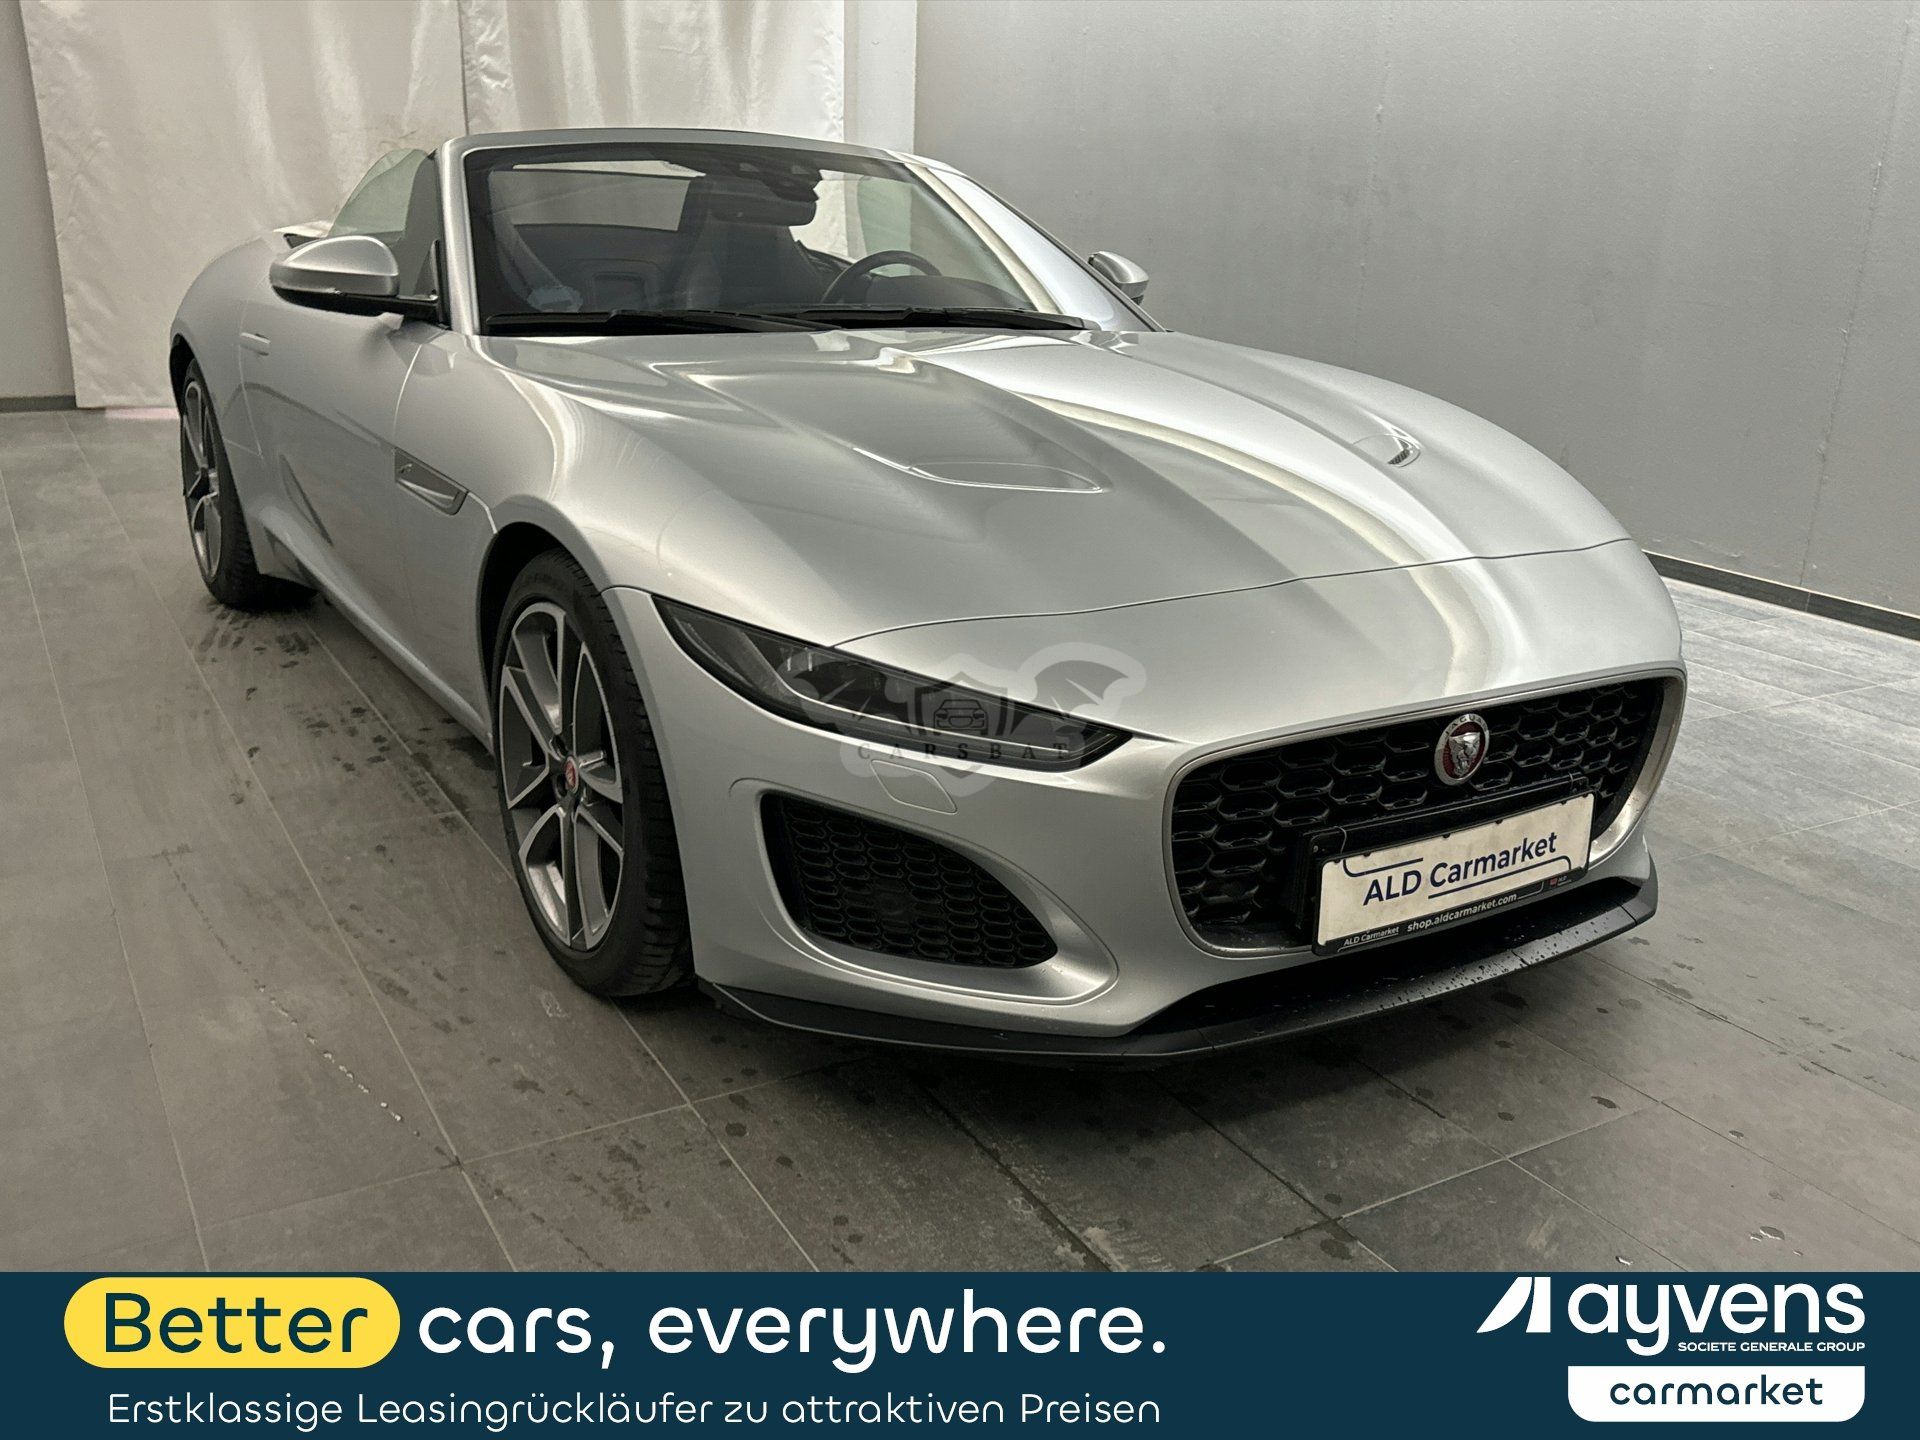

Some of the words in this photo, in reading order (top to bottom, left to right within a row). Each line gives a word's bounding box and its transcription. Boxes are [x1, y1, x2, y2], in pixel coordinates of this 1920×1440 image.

[1363, 869, 1422, 906] ALD
[1429, 832, 1558, 888] Carmarket
[1406, 893, 1518, 933] shop.aldcarmarket.com
[1343, 936, 1361, 947] ALD
[1361, 926, 1400, 942] Carmarket
